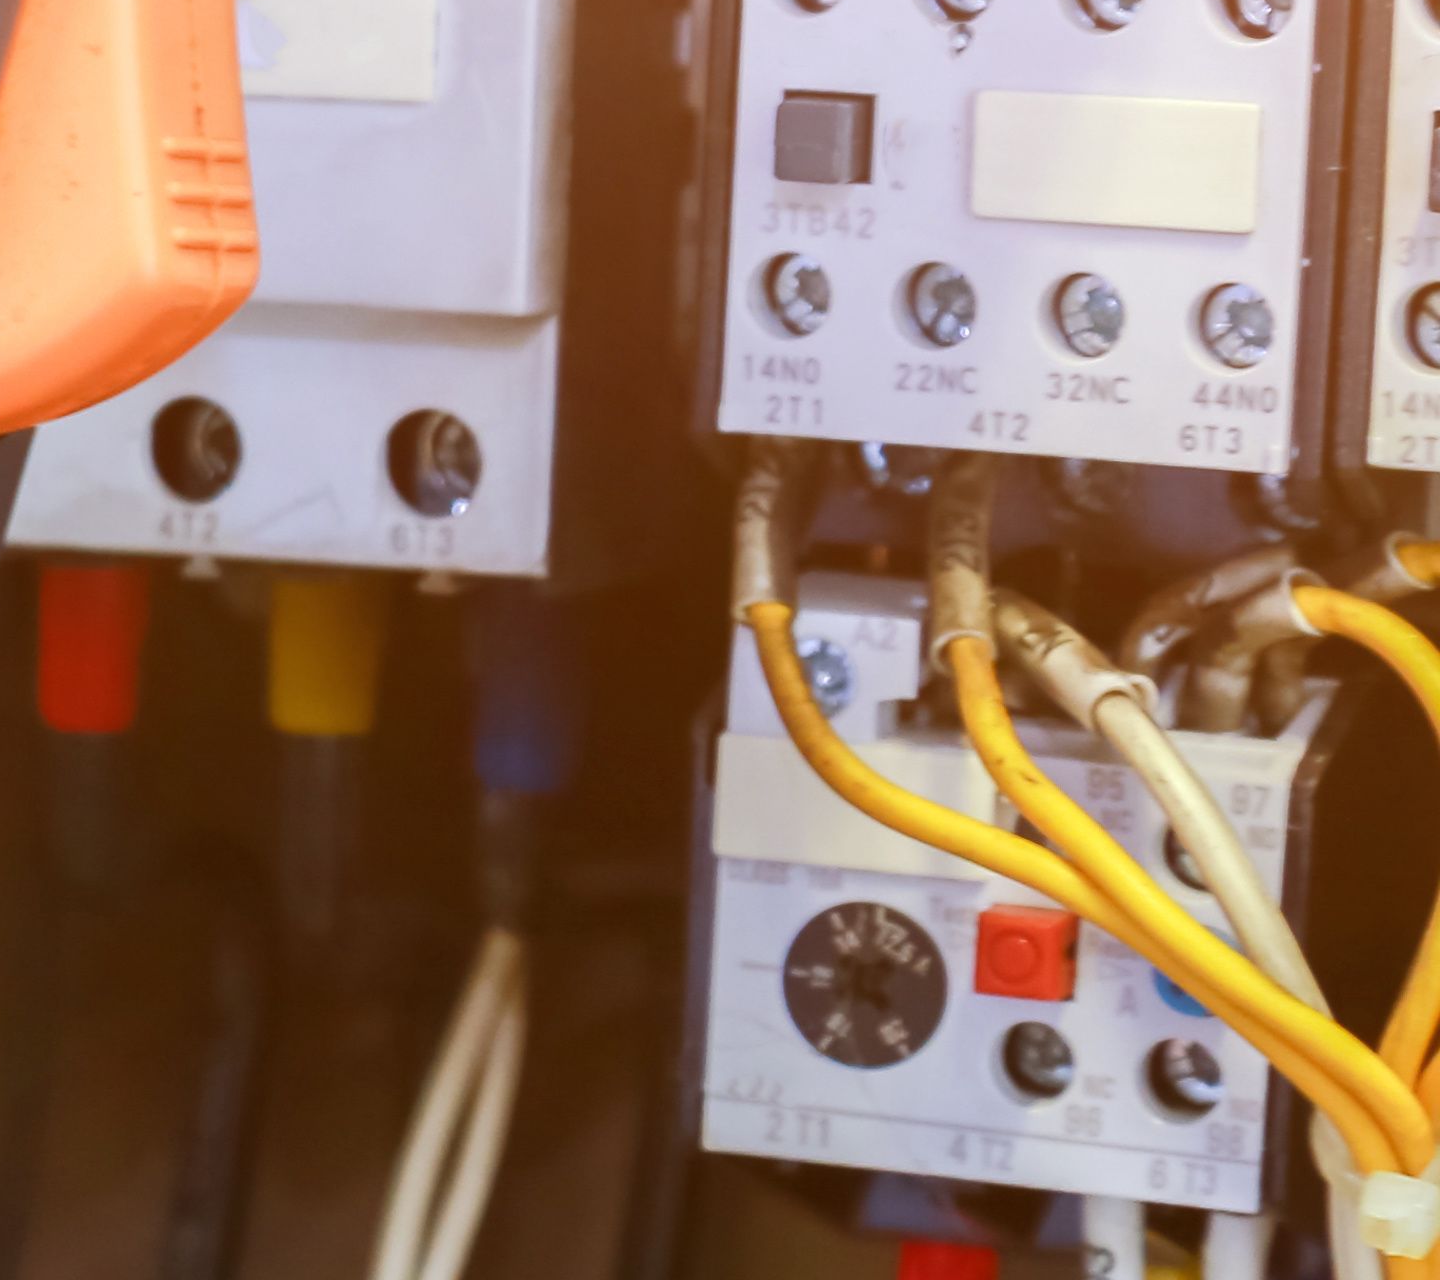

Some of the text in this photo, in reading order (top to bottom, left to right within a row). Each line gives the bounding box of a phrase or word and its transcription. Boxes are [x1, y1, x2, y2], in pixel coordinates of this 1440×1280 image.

[894, 362, 978, 396] 22NC
[1045, 372, 1132, 406] 32NC
[766, 397, 824, 427] 2T1
[968, 411, 1030, 443] 4T2
[1179, 424, 1243, 456] 6T3
[158, 509, 220, 542] 4T2
[388, 522, 454, 557] 6T3
